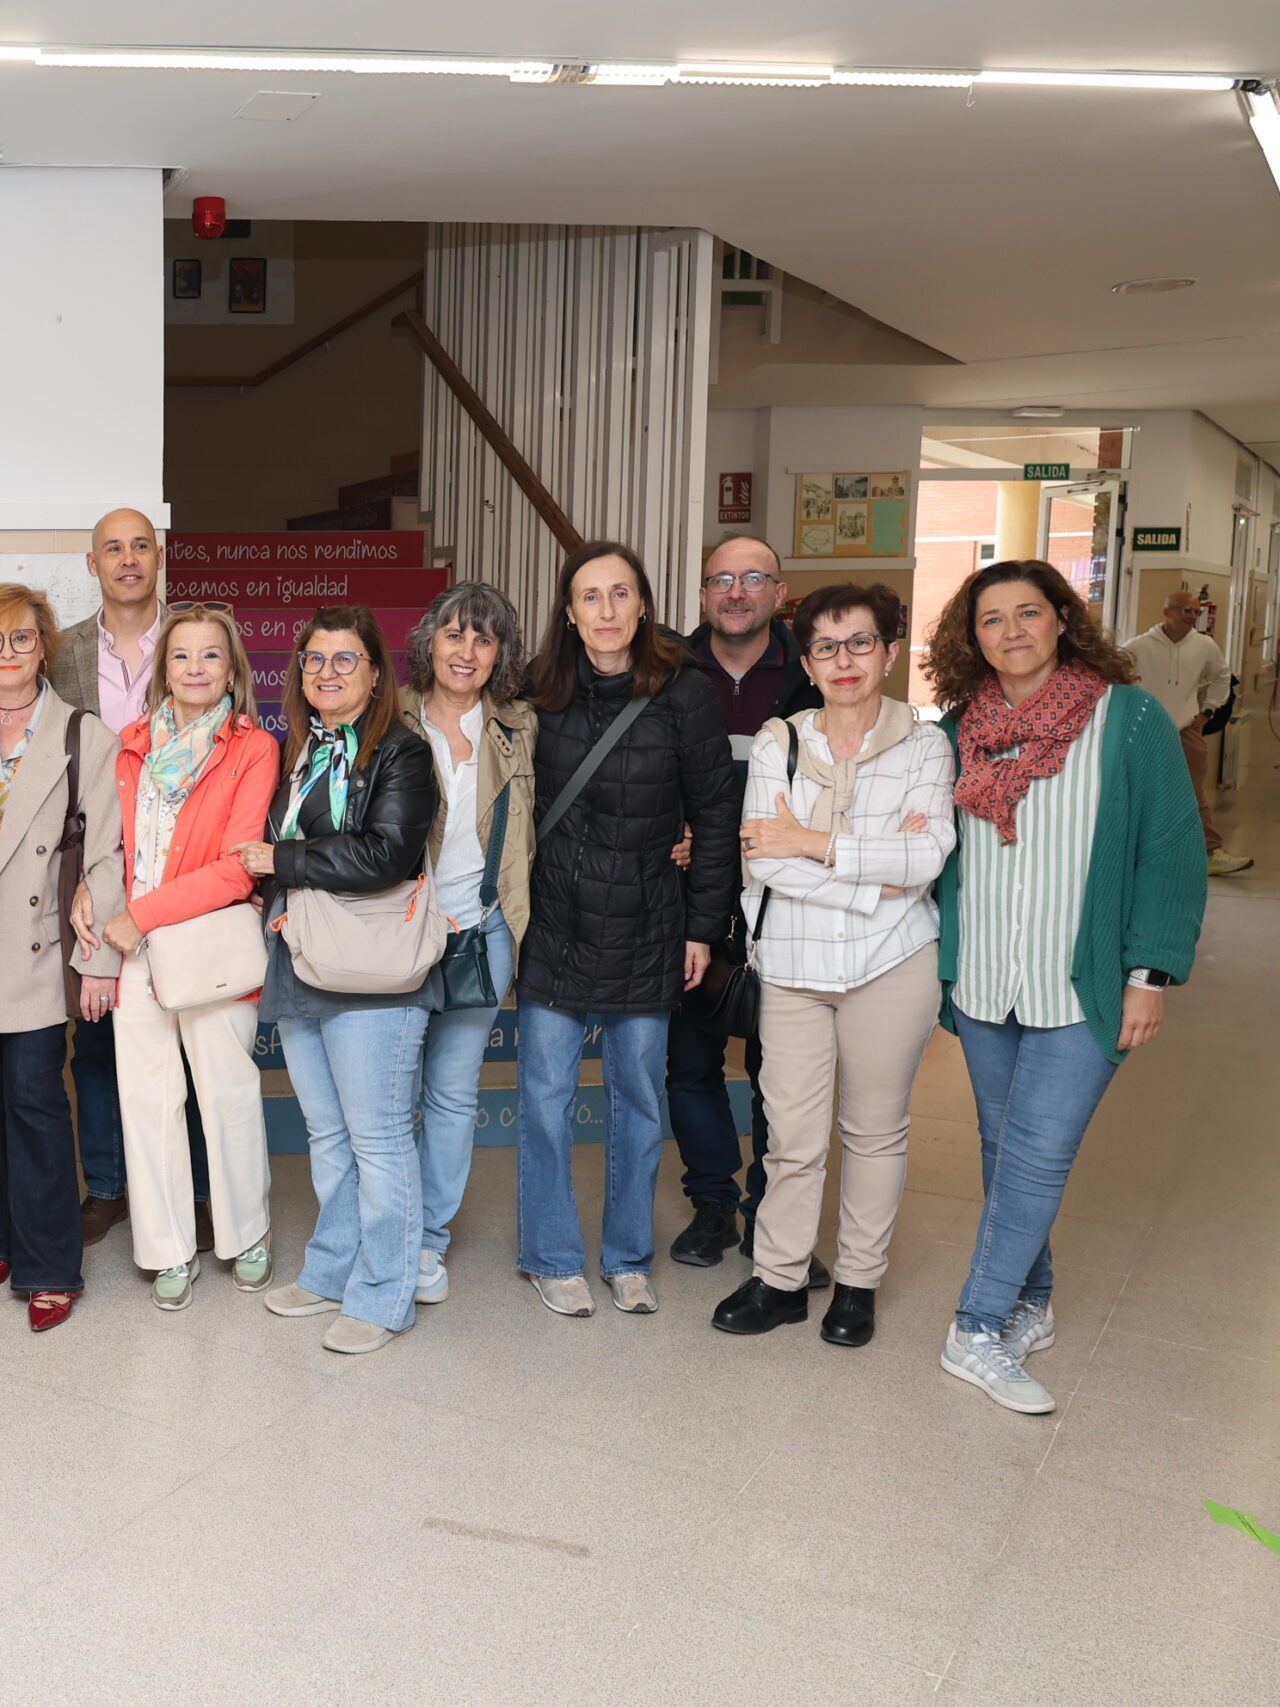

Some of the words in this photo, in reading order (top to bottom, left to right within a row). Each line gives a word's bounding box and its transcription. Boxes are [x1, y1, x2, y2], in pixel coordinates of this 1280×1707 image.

[1026, 464, 1067, 478] SALIDA
[720, 510, 750, 521] EXTINTOR
[1136, 533, 1177, 546] SALIDA
[166, 540, 210, 563] ntes,
[217, 544, 270, 560] nunca
[277, 544, 308, 560] nos
[314, 538, 398, 560] rendimos
[166, 580, 240, 597] ecemos
[246, 580, 270, 597] en
[277, 574, 348, 603] igualdad
[261, 620, 286, 637] en
